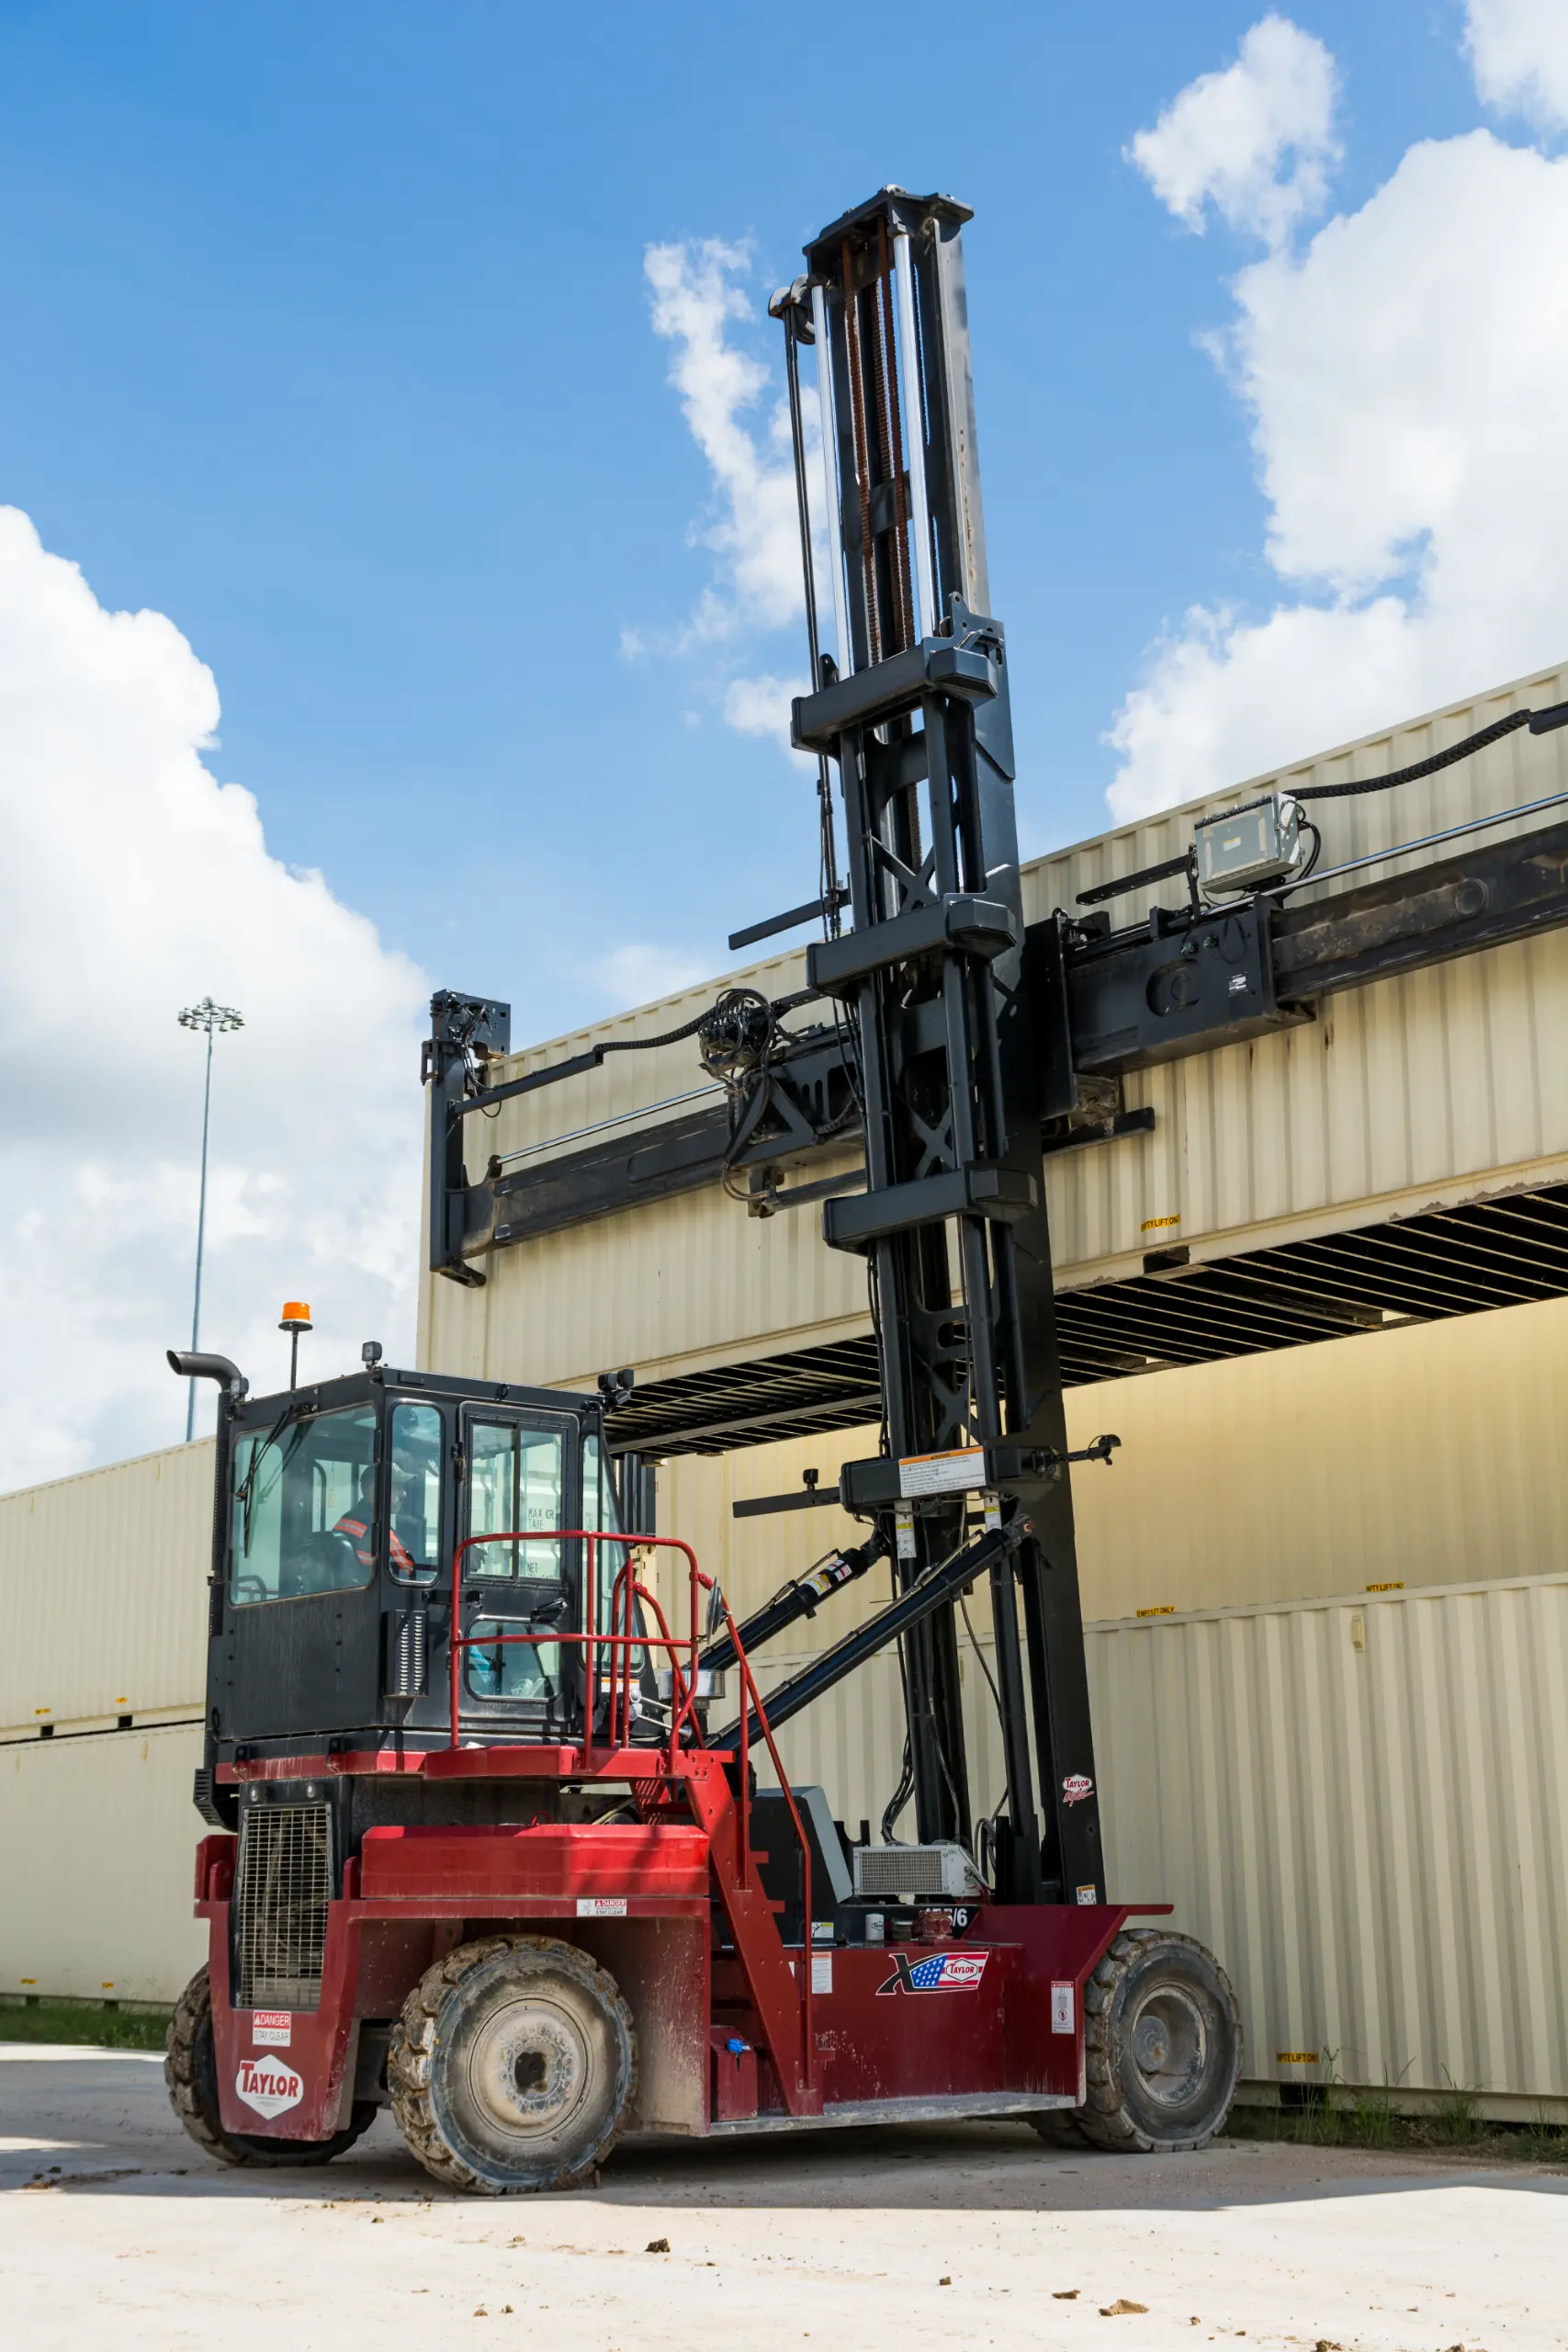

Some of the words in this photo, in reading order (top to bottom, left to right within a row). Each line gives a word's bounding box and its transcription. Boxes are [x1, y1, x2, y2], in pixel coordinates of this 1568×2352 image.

[527, 1563, 537, 1573] NET
[1159, 1606, 1175, 1614] ONLY
[1066, 1778, 1089, 1788] TAYLOR
[950, 1963, 975, 1974] TAYLOR
[260, 2015, 290, 2027] DANGER
[254, 2030, 268, 2041] STAY
[268, 2031, 289, 2041] CLEAR
[240, 2063, 299, 2098] TAYLOR
